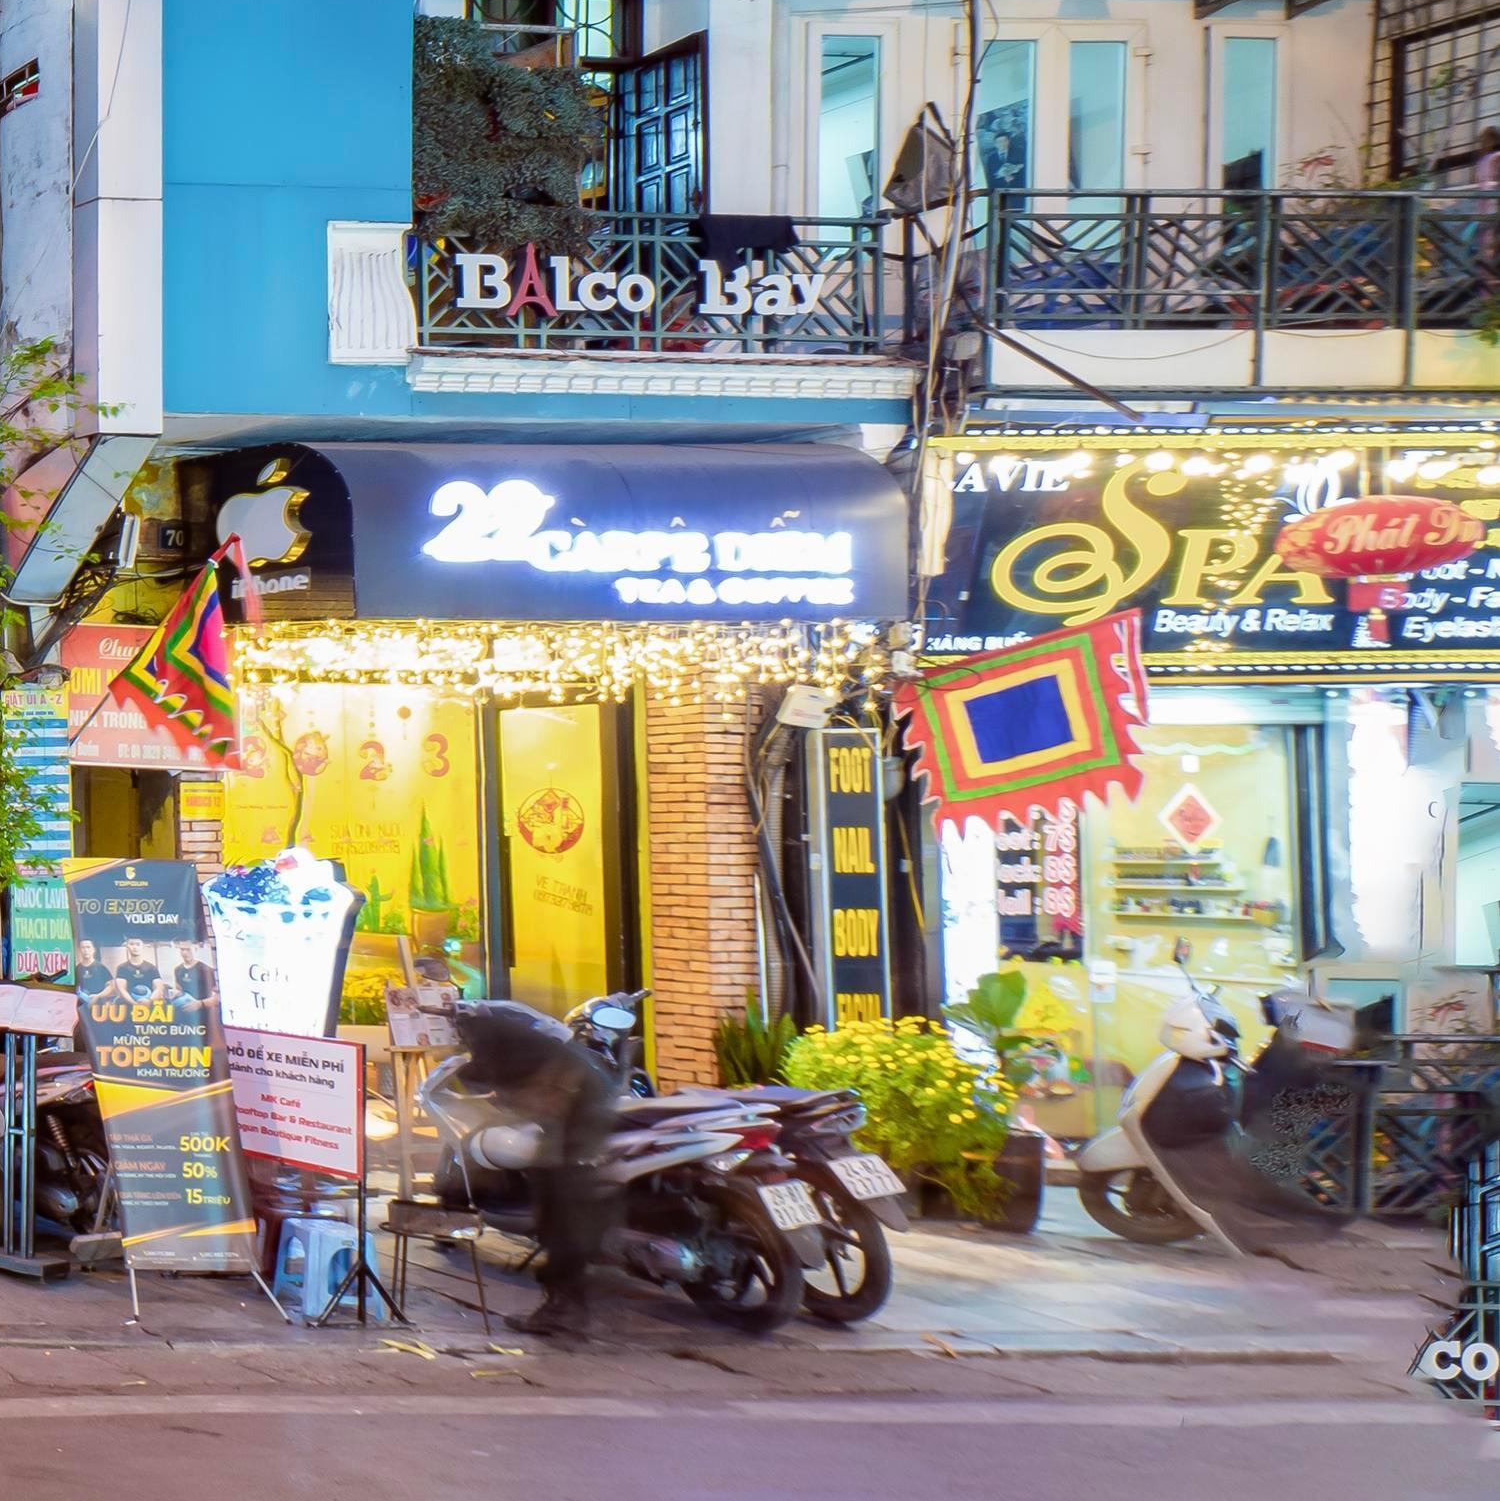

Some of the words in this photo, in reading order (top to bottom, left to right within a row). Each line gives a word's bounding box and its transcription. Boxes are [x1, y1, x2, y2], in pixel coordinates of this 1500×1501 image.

[1153, 609, 1240, 638] Beauty
[1240, 609, 1262, 632] &
[1263, 609, 1336, 632] Relax
[829, 746, 873, 794] FOOT
[832, 826, 876, 874] NAIL
[76, 899, 101, 914] TO
[104, 899, 165, 914] ENJOY
[124, 913, 155, 925] YOUR
[158, 913, 180, 925] DAY
[833, 908, 880, 958] BODY
[91, 1002, 127, 1022] ƯU
[131, 1000, 175, 1023] ĐÃI
[95, 1045, 213, 1068] TOPGUN
[266, 1051, 283, 1064] XE
[136, 1067, 162, 1078] KHAI
[255, 1066, 274, 1078] cho
[275, 1069, 307, 1083] khách
[308, 1075, 336, 1090] hàng
[270, 1111, 288, 1123] Bar
[298, 1117, 353, 1136] Restaurant
[179, 1135, 231, 1153] 500K
[260, 1124, 303, 1142] Boutique
[304, 1135, 341, 1150] Fitness
[182, 1161, 218, 1179] 50%
